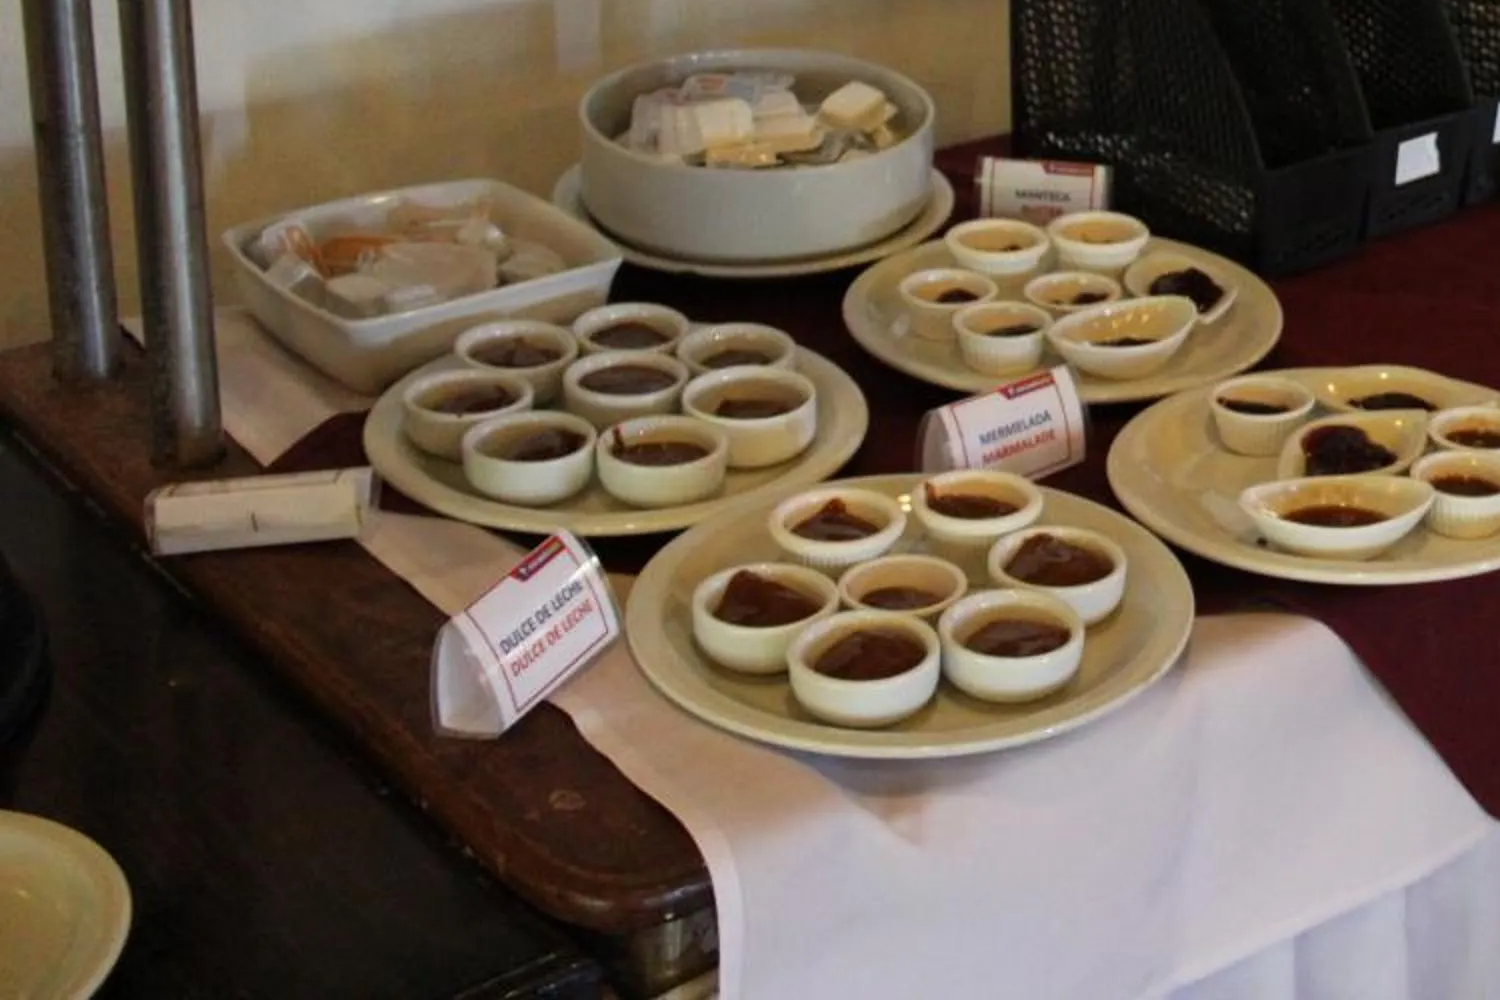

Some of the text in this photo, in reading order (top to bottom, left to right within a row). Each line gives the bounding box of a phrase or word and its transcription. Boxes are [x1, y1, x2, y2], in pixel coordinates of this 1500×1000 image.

[979, 409, 1052, 444] MERMELADA
[500, 580, 584, 655] DULCE DE LECHE
[511, 598, 594, 677] DULCE DE LECHE
